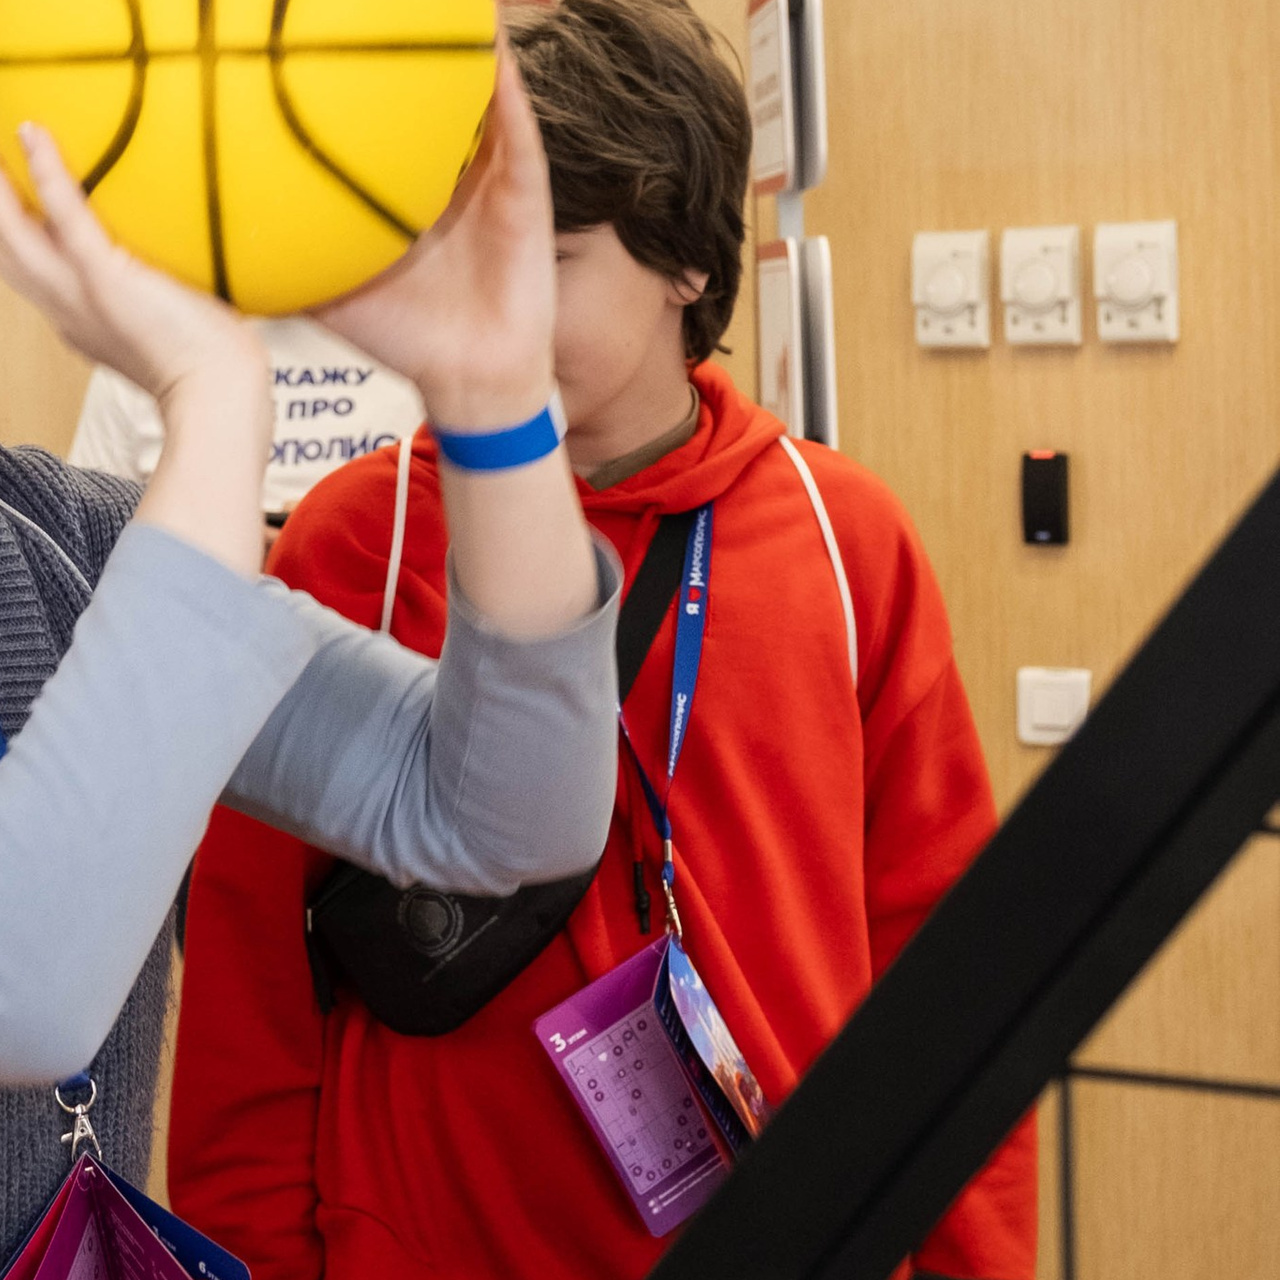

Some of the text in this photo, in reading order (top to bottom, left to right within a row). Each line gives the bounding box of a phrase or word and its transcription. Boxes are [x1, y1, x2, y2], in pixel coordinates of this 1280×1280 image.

[287, 397, 354, 420] ПРО
[686, 602, 700, 615] Я
[548, 1031, 567, 1053] 3
[198, 1261, 206, 1274] 6
